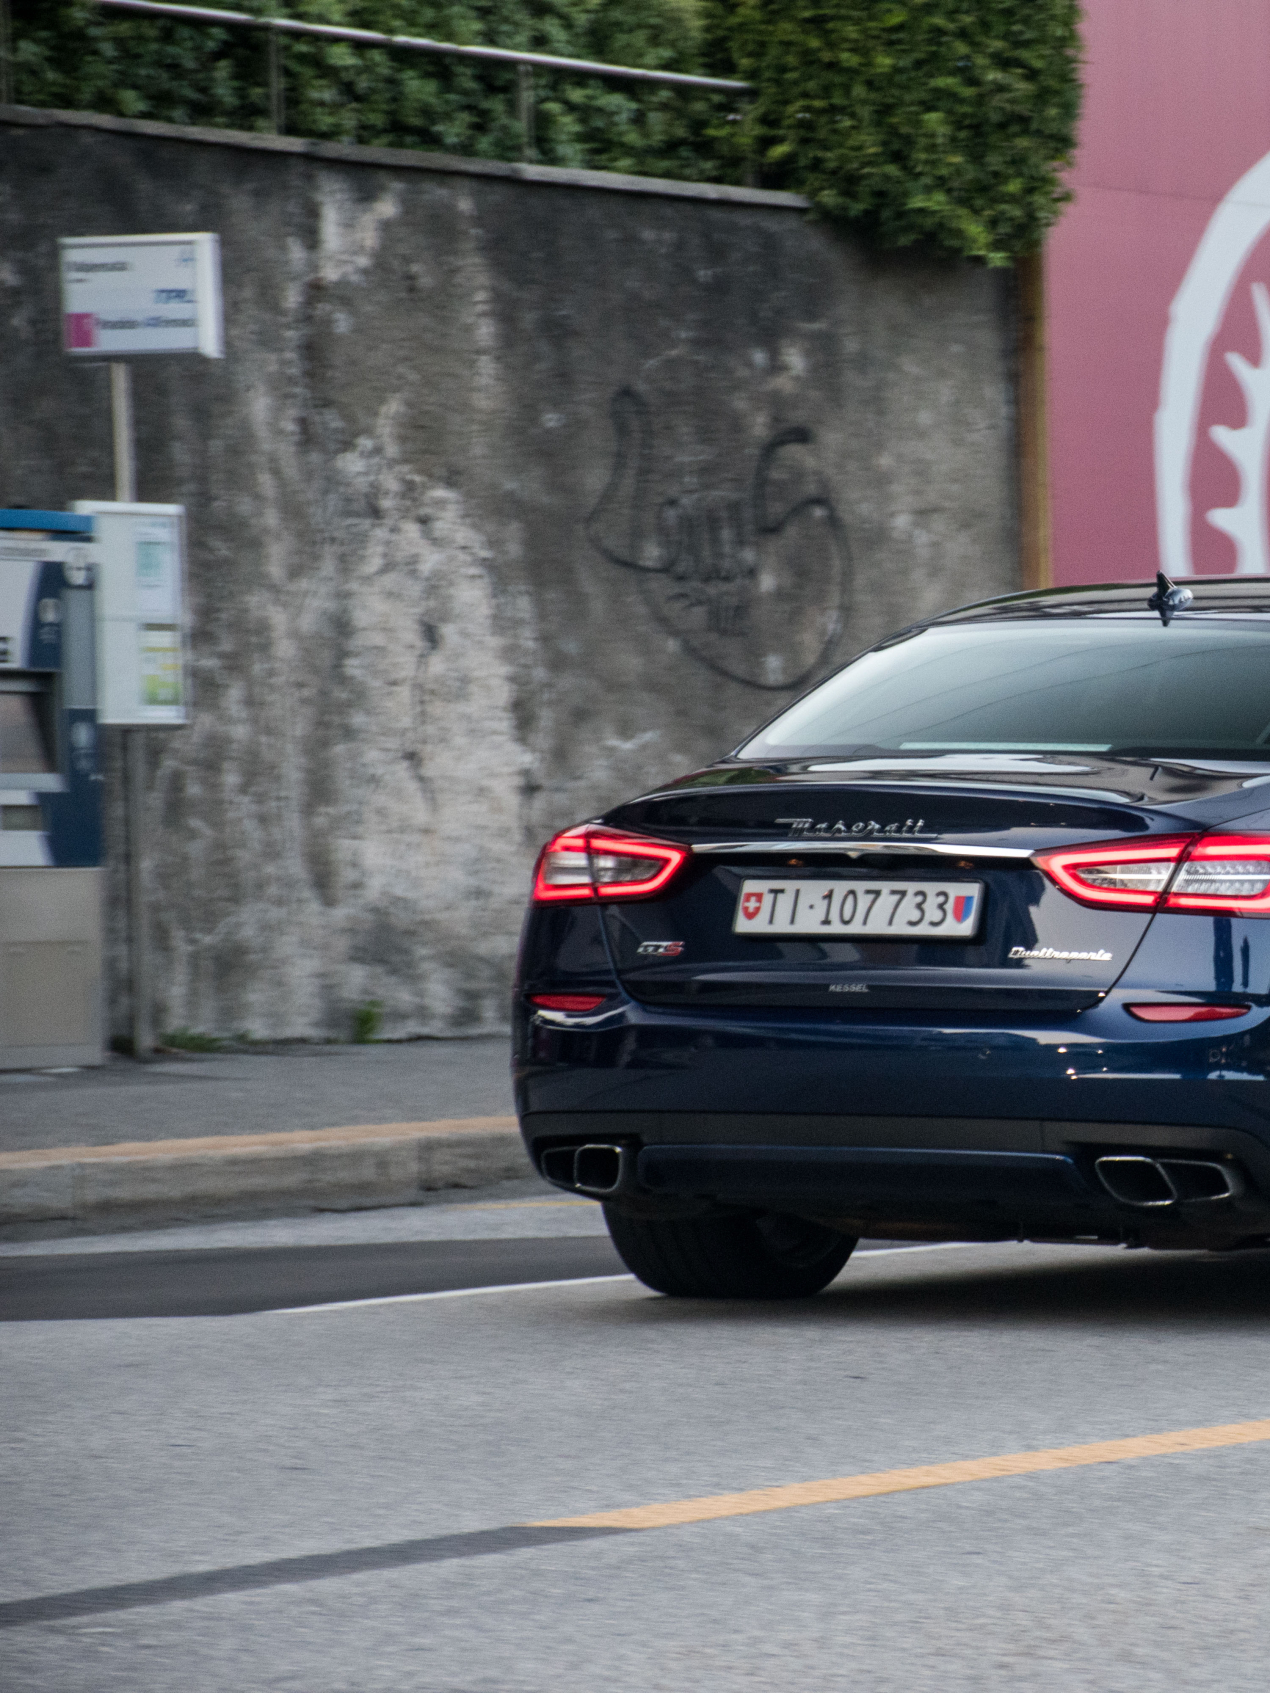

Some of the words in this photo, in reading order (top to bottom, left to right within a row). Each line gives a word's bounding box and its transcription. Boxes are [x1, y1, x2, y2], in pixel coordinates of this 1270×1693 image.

[774, 818, 939, 838] Maserati
[637, 941, 685, 956] GTS
[1007, 946, 1112, 963] Quattroporte
[829, 984, 870, 993] KESSEL
